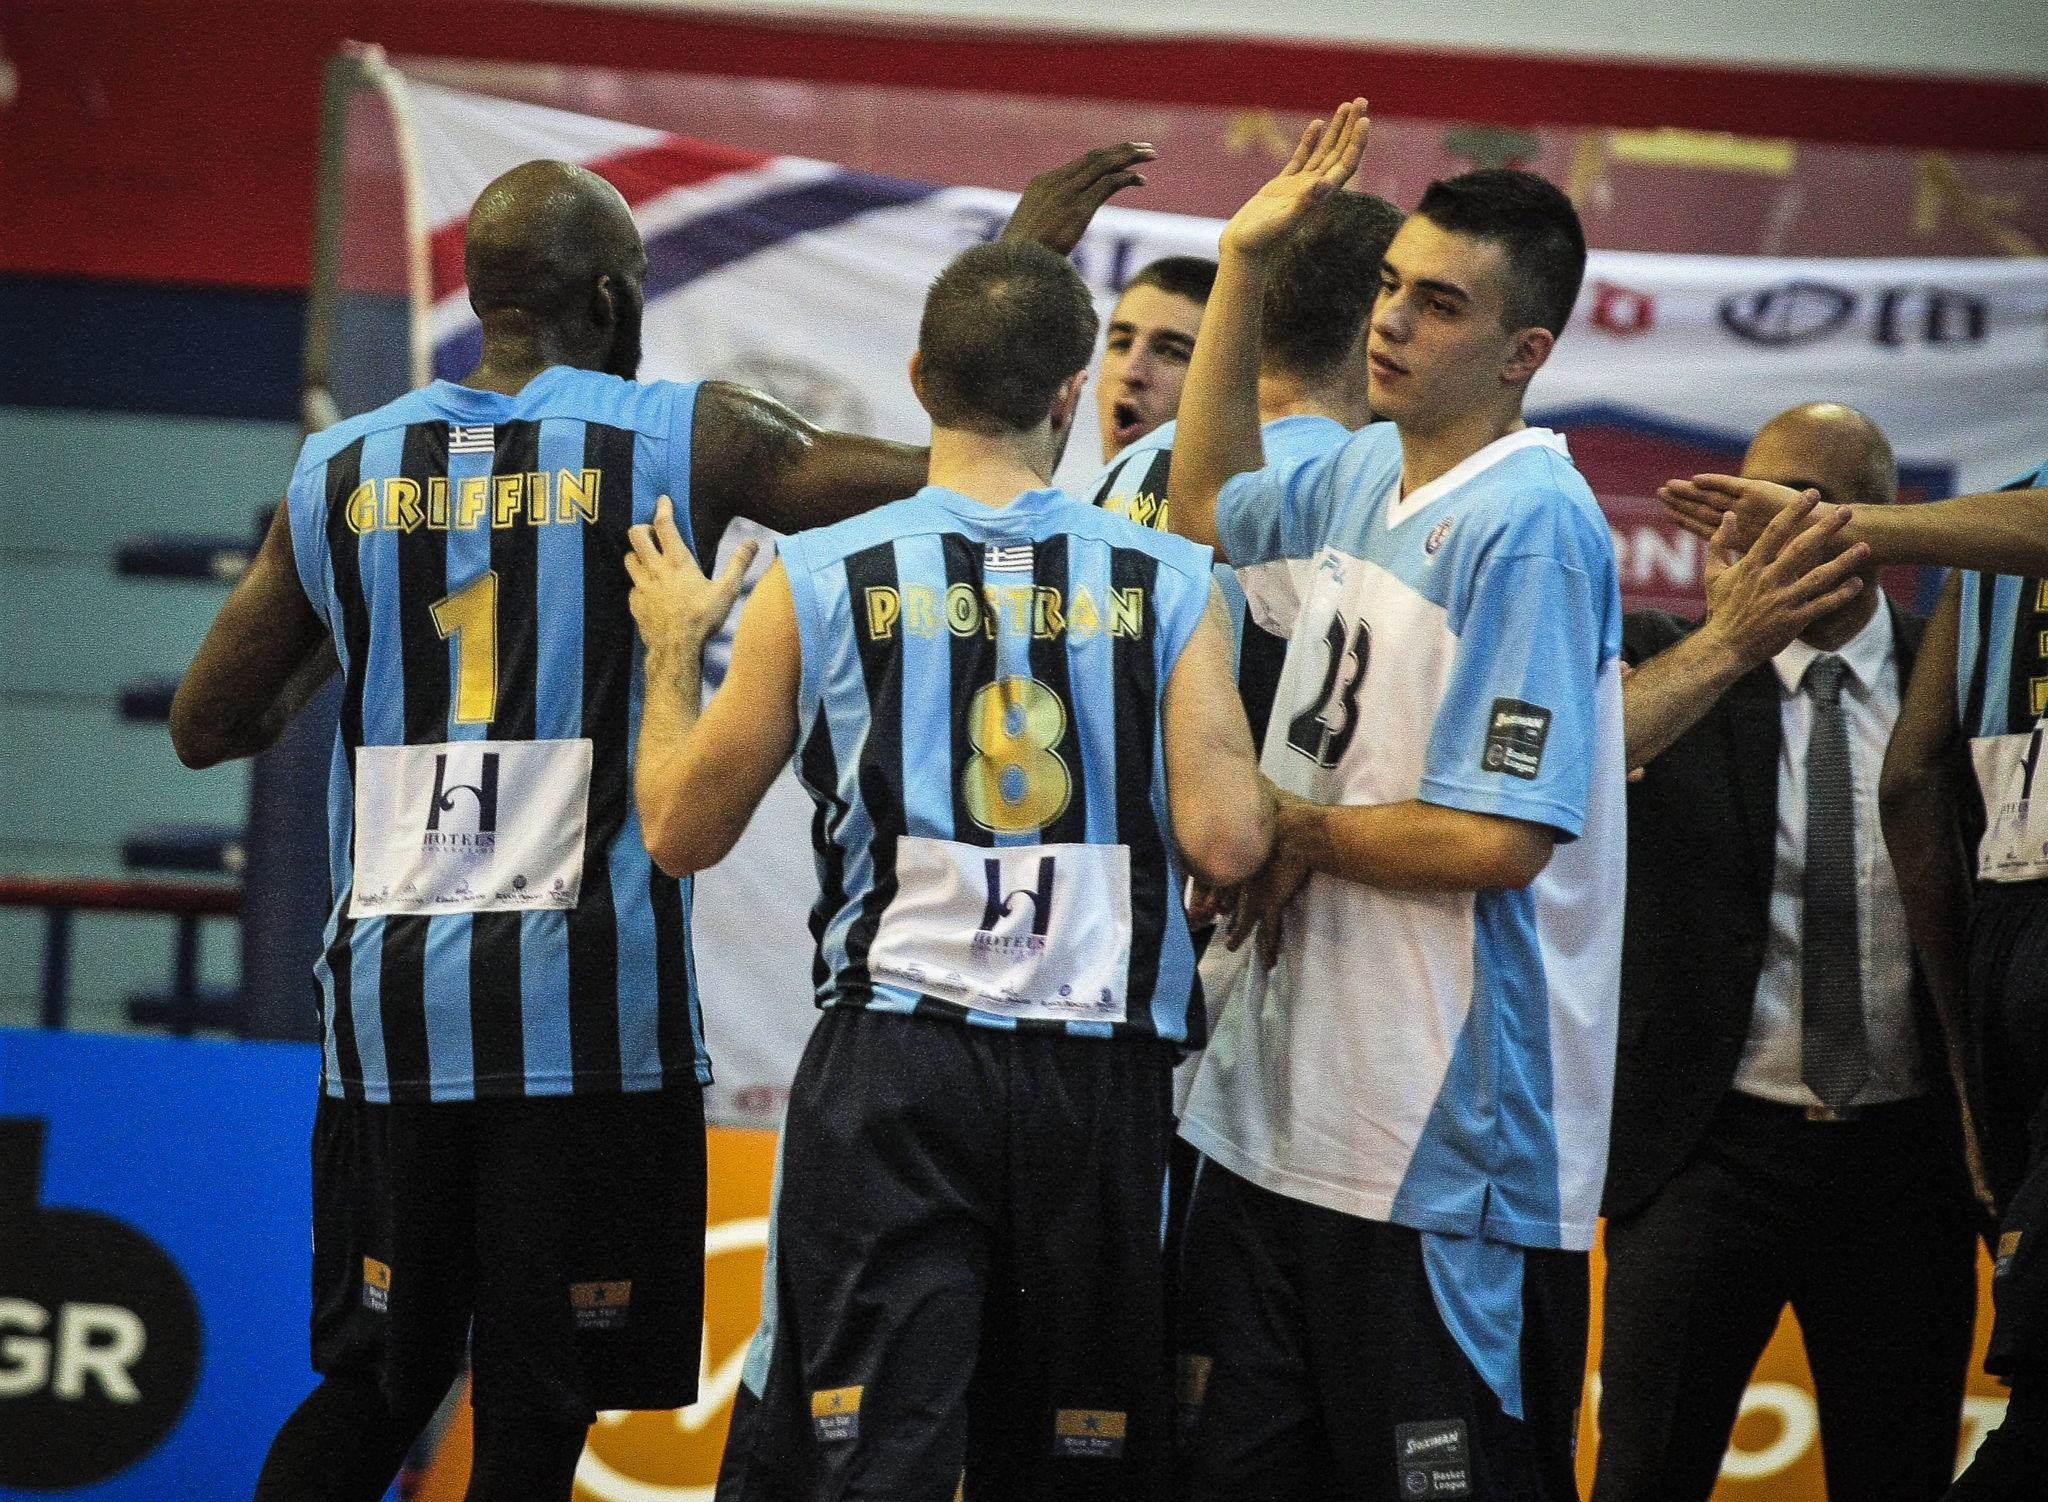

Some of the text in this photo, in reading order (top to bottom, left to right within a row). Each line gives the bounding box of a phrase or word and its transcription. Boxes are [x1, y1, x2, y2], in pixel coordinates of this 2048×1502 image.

[346, 468, 601, 534] GRIFFIN
[428, 568, 498, 725] 1
[864, 582, 1145, 641] PROSTRAN
[962, 673, 1073, 835] 8
[0, 1299, 144, 1401] GR
